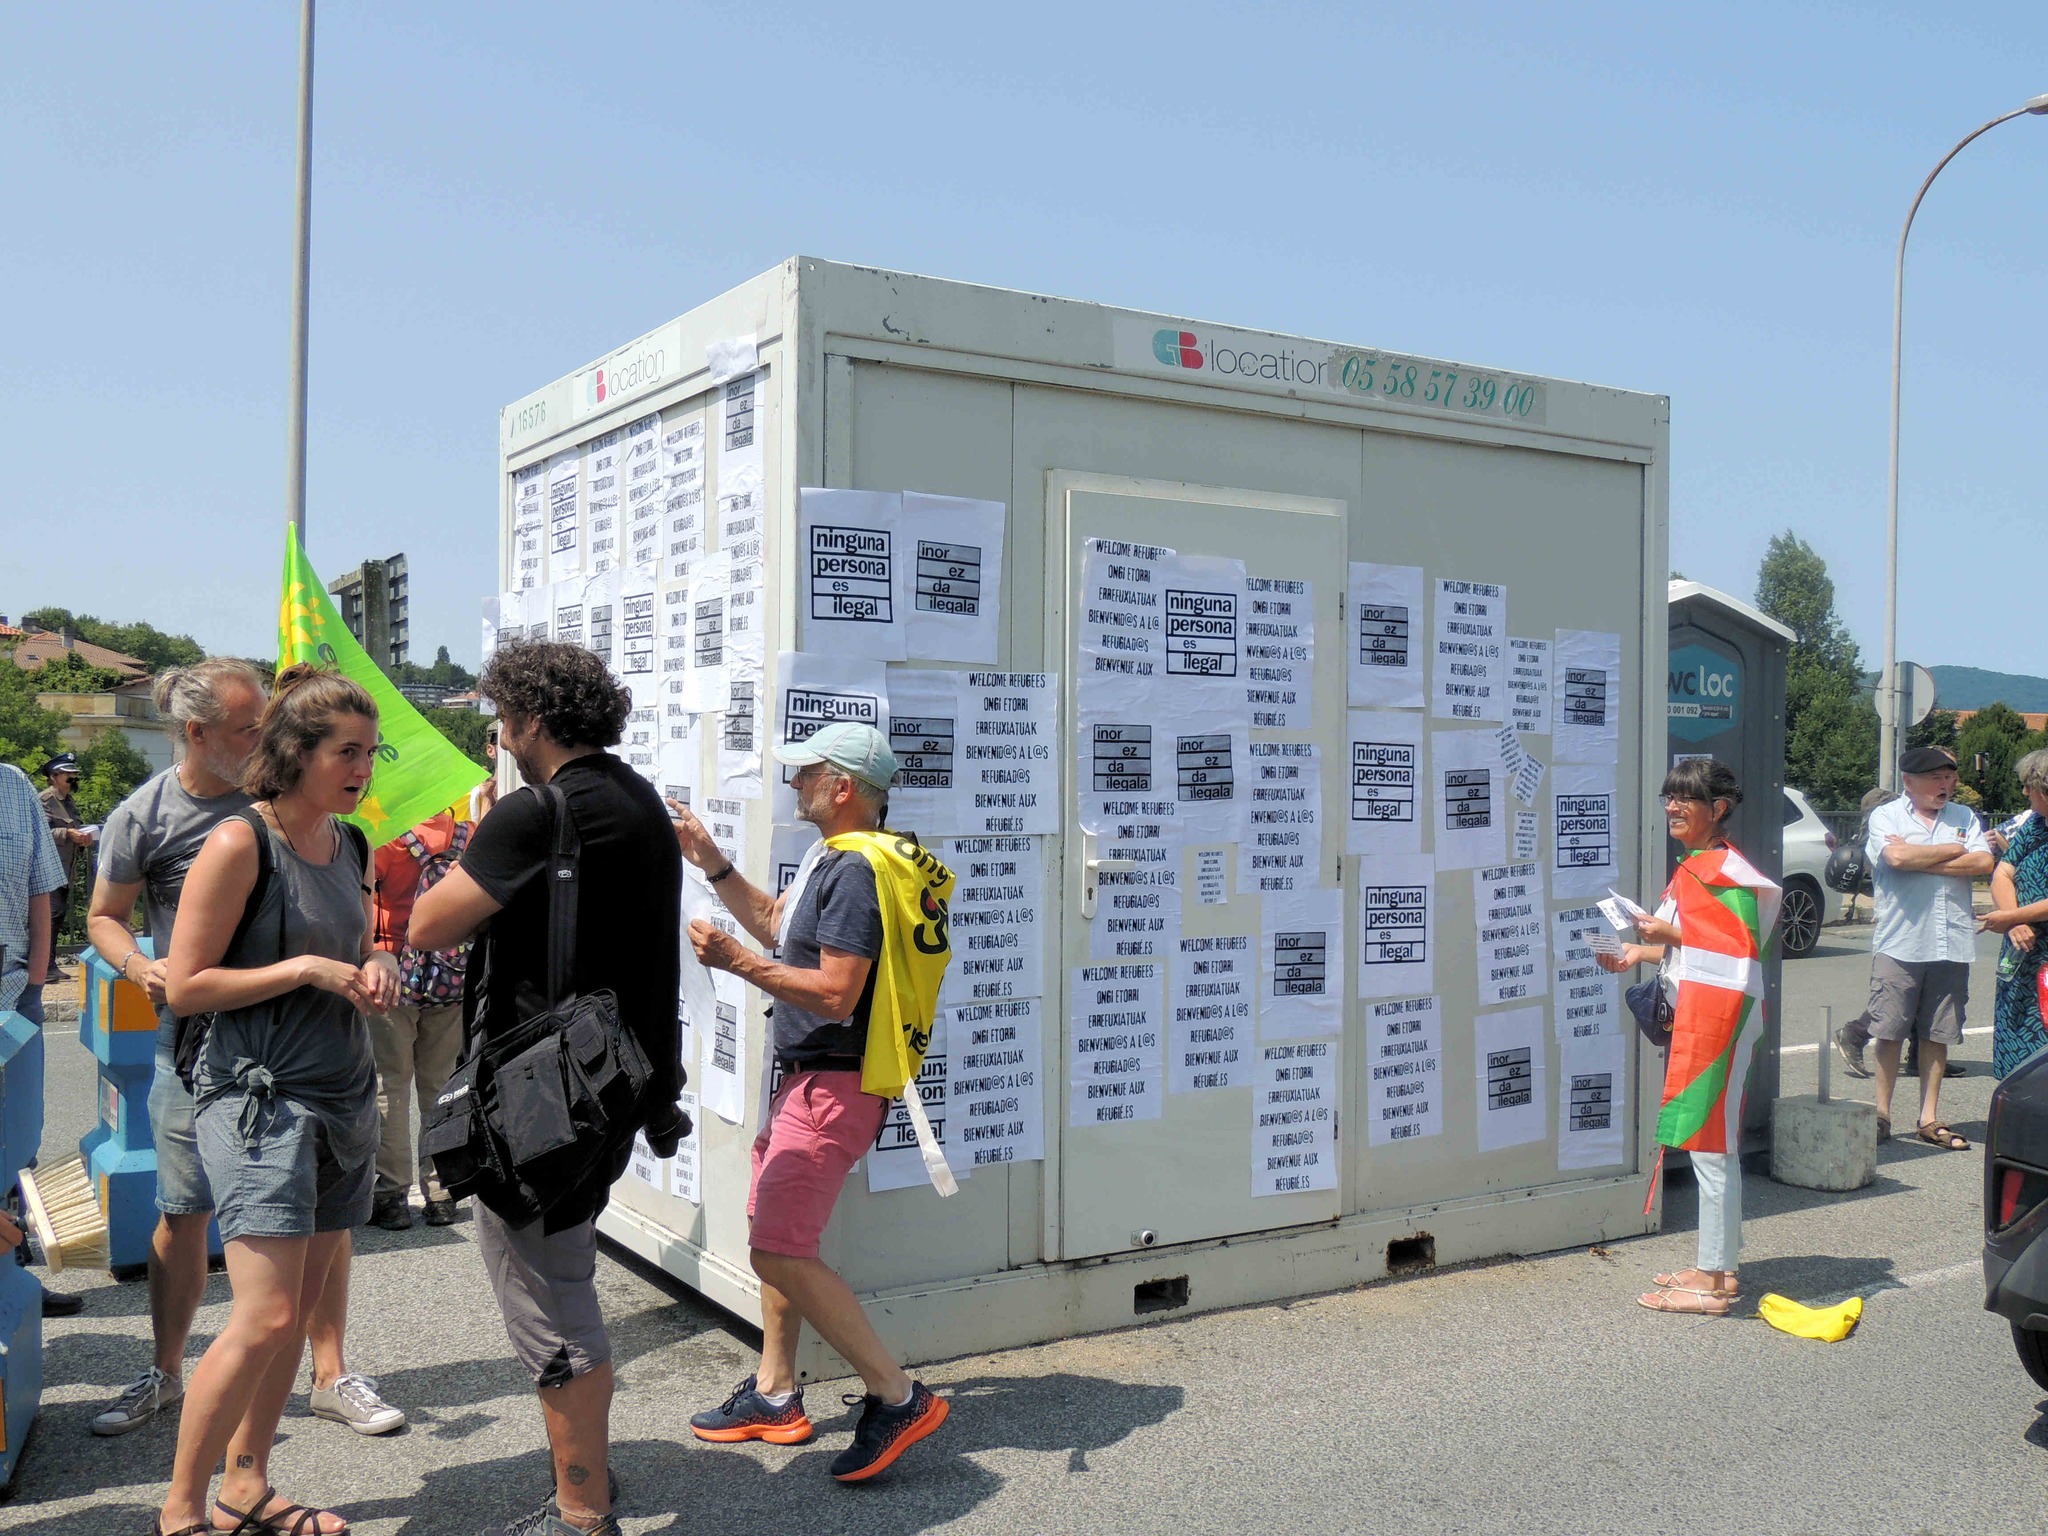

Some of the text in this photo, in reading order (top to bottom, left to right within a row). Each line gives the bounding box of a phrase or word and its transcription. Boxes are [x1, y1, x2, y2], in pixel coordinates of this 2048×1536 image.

[608, 349, 664, 397] location
[728, 382, 740, 397] inor
[1342, 355, 1535, 417] 05 58 57 39 00
[740, 400, 748, 411] ez
[732, 418, 740, 430] da
[731, 432, 751, 448] ilegala
[552, 480, 575, 498] ninguna
[553, 501, 575, 518] persona
[556, 522, 562, 530] es
[556, 534, 572, 548] ilegal
[816, 530, 885, 553] ninguna
[922, 544, 950, 559] inor
[817, 557, 886, 577] persona
[949, 567, 965, 578] ez
[832, 579, 849, 592] es
[933, 580, 950, 593] da
[1443, 581, 1499, 598] WELCOME REFUGEES
[626, 598, 651, 616] ninguna
[833, 596, 877, 618] ilegal
[930, 596, 975, 614] ilegala
[1170, 594, 1232, 615] ninguna
[1454, 602, 1487, 616] ONGI ETORRI
[1363, 608, 1385, 619] inor
[626, 619, 652, 635] persona
[1170, 618, 1232, 635] persona
[1384, 625, 1396, 634] ez
[1447, 622, 1492, 636] ERREFUXIATUAK
[630, 641, 636, 650] es
[1183, 639, 1197, 649] es
[1372, 638, 1385, 648] da
[1440, 642, 1499, 658] BIENVENID@S A L@S
[630, 654, 647, 670] ilegal
[1183, 654, 1222, 673] ilegal
[1371, 652, 1405, 665] ilegala
[1450, 664, 1486, 677] REFUGIAD@S
[1568, 671, 1586, 682] inor
[969, 673, 1046, 688] WELCOME REFUGEES
[1446, 684, 1490, 698] BIENVENUE AUX
[1585, 687, 1596, 696] ez
[793, 694, 872, 718] ninguna
[984, 697, 1028, 712] ONGI ETORRI
[1575, 699, 1586, 709] da
[1673, 706, 1684, 714] 001
[1687, 706, 1698, 714] 092
[1573, 713, 1603, 725] ilegala
[894, 721, 921, 733] inor
[976, 721, 1037, 736] ERREFUXIATUAK
[1097, 728, 1123, 739] inor
[923, 740, 939, 751] ez
[1122, 746, 1137, 756] ez
[1180, 739, 1204, 750] inor
[966, 745, 1049, 761] BIENVENID@S A L@S
[1357, 747, 1410, 764] ninguna
[905, 755, 923, 768] da
[1108, 761, 1124, 773] da
[1205, 756, 1219, 766] ez
[902, 772, 949, 787] ilegala
[981, 769, 1030, 784] REFUGIAD@S
[1106, 777, 1148, 790] ilegala
[1191, 771, 1206, 782] da
[1357, 768, 1410, 784] persona
[1448, 773, 1467, 784] inor
[1190, 786, 1230, 798] ilegala
[1367, 788, 1378, 796] es
[1468, 787, 1479, 797] ez
[975, 794, 1037, 808] BIENVENUE AUX
[1457, 801, 1470, 812] da
[1560, 799, 1606, 814] ninguna
[1367, 802, 1400, 818] ilegal
[1456, 816, 1488, 828] ilegala
[1560, 817, 1606, 832] persona
[1570, 836, 1580, 845] es
[1570, 849, 1599, 865] ilegal
[1482, 863, 1535, 881] WELCOME REFUGEES
[1369, 891, 1422, 907] ninguna
[1494, 884, 1526, 900] ONGI ETORRI
[1370, 911, 1422, 927] persona
[1488, 904, 1532, 920] ERREFUXIATUAK
[1379, 930, 1391, 939] es
[1482, 922, 1540, 942] BIENVENID@S A L@S
[1278, 936, 1300, 946] inor
[1300, 952, 1312, 961] ez
[1379, 944, 1413, 961] ilegal
[1494, 944, 1529, 959] REFUGIAD@S
[1082, 965, 1153, 981] WELCOME REFUGEES
[1287, 967, 1301, 977] da
[1491, 963, 1533, 981] BIENVENUE AUX
[1285, 981, 1322, 993] ilegala
[1097, 989, 1139, 1004] ONGI ETORRI
[956, 1001, 1030, 1022] WELCOME REFUGEES
[1088, 1011, 1146, 1028] ERREFUXIATUAK
[972, 1027, 1016, 1045] ONGI ETORRI
[1079, 1033, 1155, 1052] BIENVENID@S A L@S
[963, 1050, 1024, 1069] ERREFUXIATUAK
[1094, 1058, 1140, 1074] REFUGIAD@S
[1490, 1054, 1509, 1066] inor
[1509, 1067, 1520, 1077] ez
[954, 1072, 1033, 1095] BIENVENID@S A L@S
[1088, 1081, 1145, 1098] BIENVENUE AUX
[1499, 1081, 1511, 1092] da
[1574, 1078, 1591, 1088] inor
[1498, 1093, 1529, 1107] ilegala
[1591, 1090, 1601, 1100] ez
[969, 1099, 1018, 1117] REFUGIAD@S
[1581, 1104, 1592, 1115] da
[1578, 1117, 1609, 1128] ilegala
[897, 1122, 942, 1143] ileal
[964, 1121, 1024, 1142] BIENVENUE AUX
